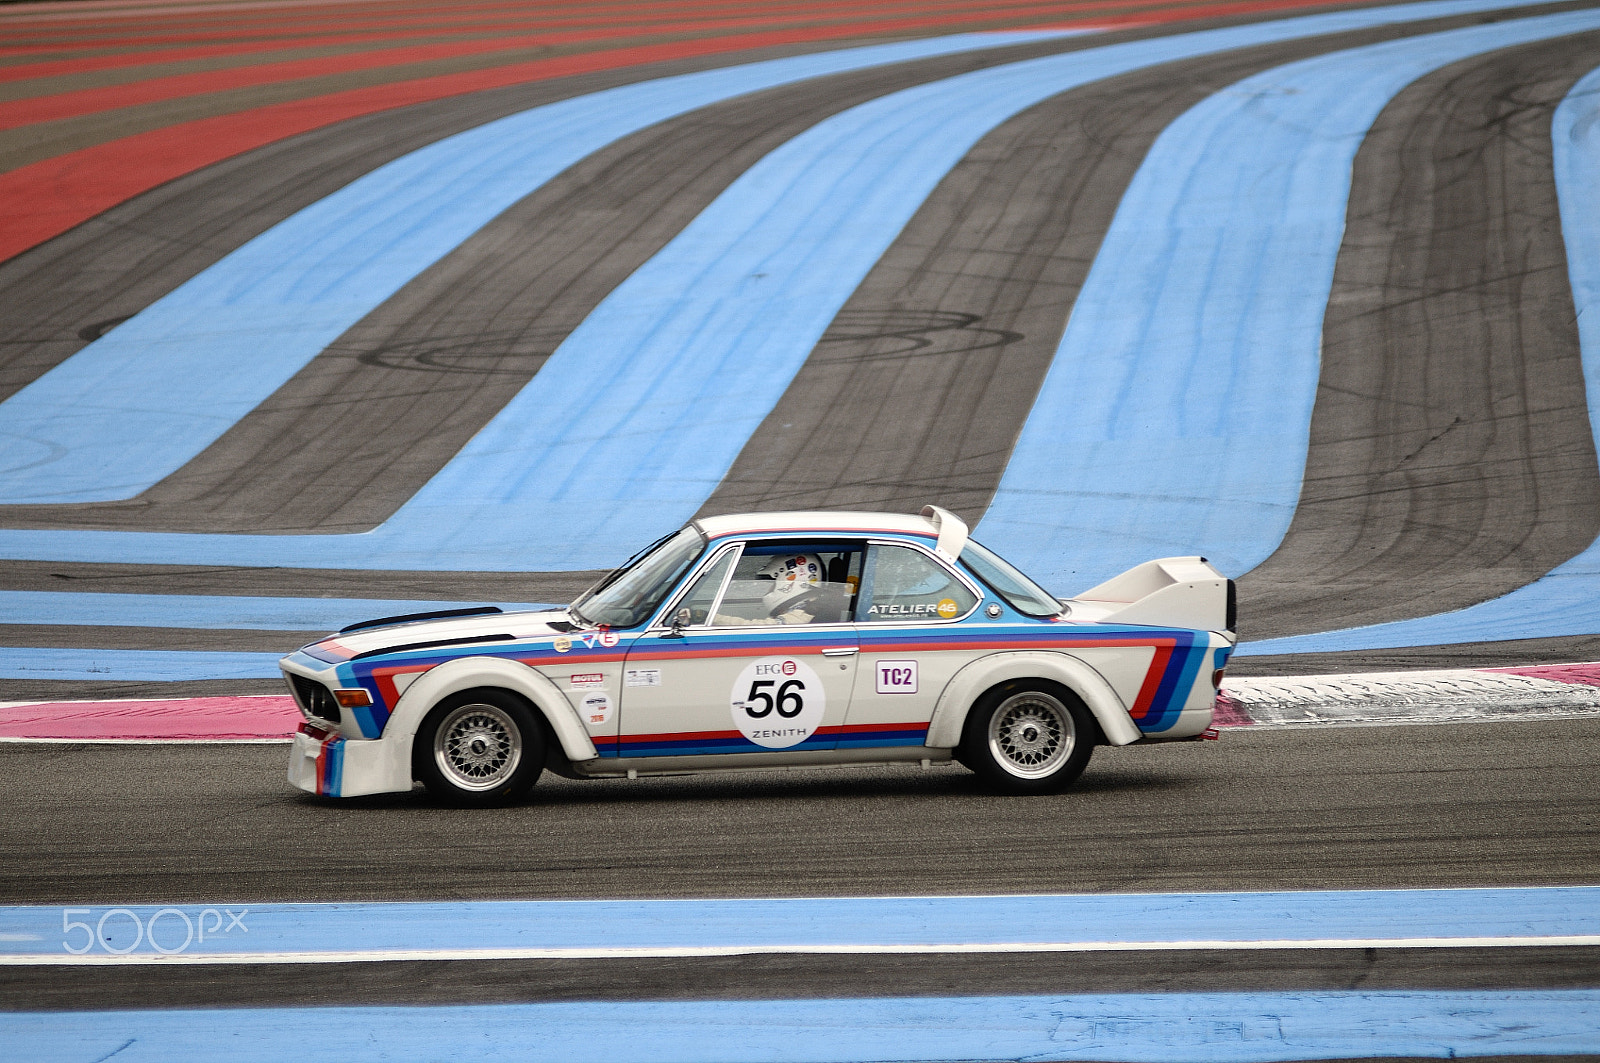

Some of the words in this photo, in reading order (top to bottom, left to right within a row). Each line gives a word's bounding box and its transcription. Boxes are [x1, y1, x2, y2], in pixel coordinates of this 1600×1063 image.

[756, 664, 781, 675] EFG
[881, 668, 912, 686] TC2
[745, 679, 806, 719] 56
[752, 728, 807, 739] ZENITH
